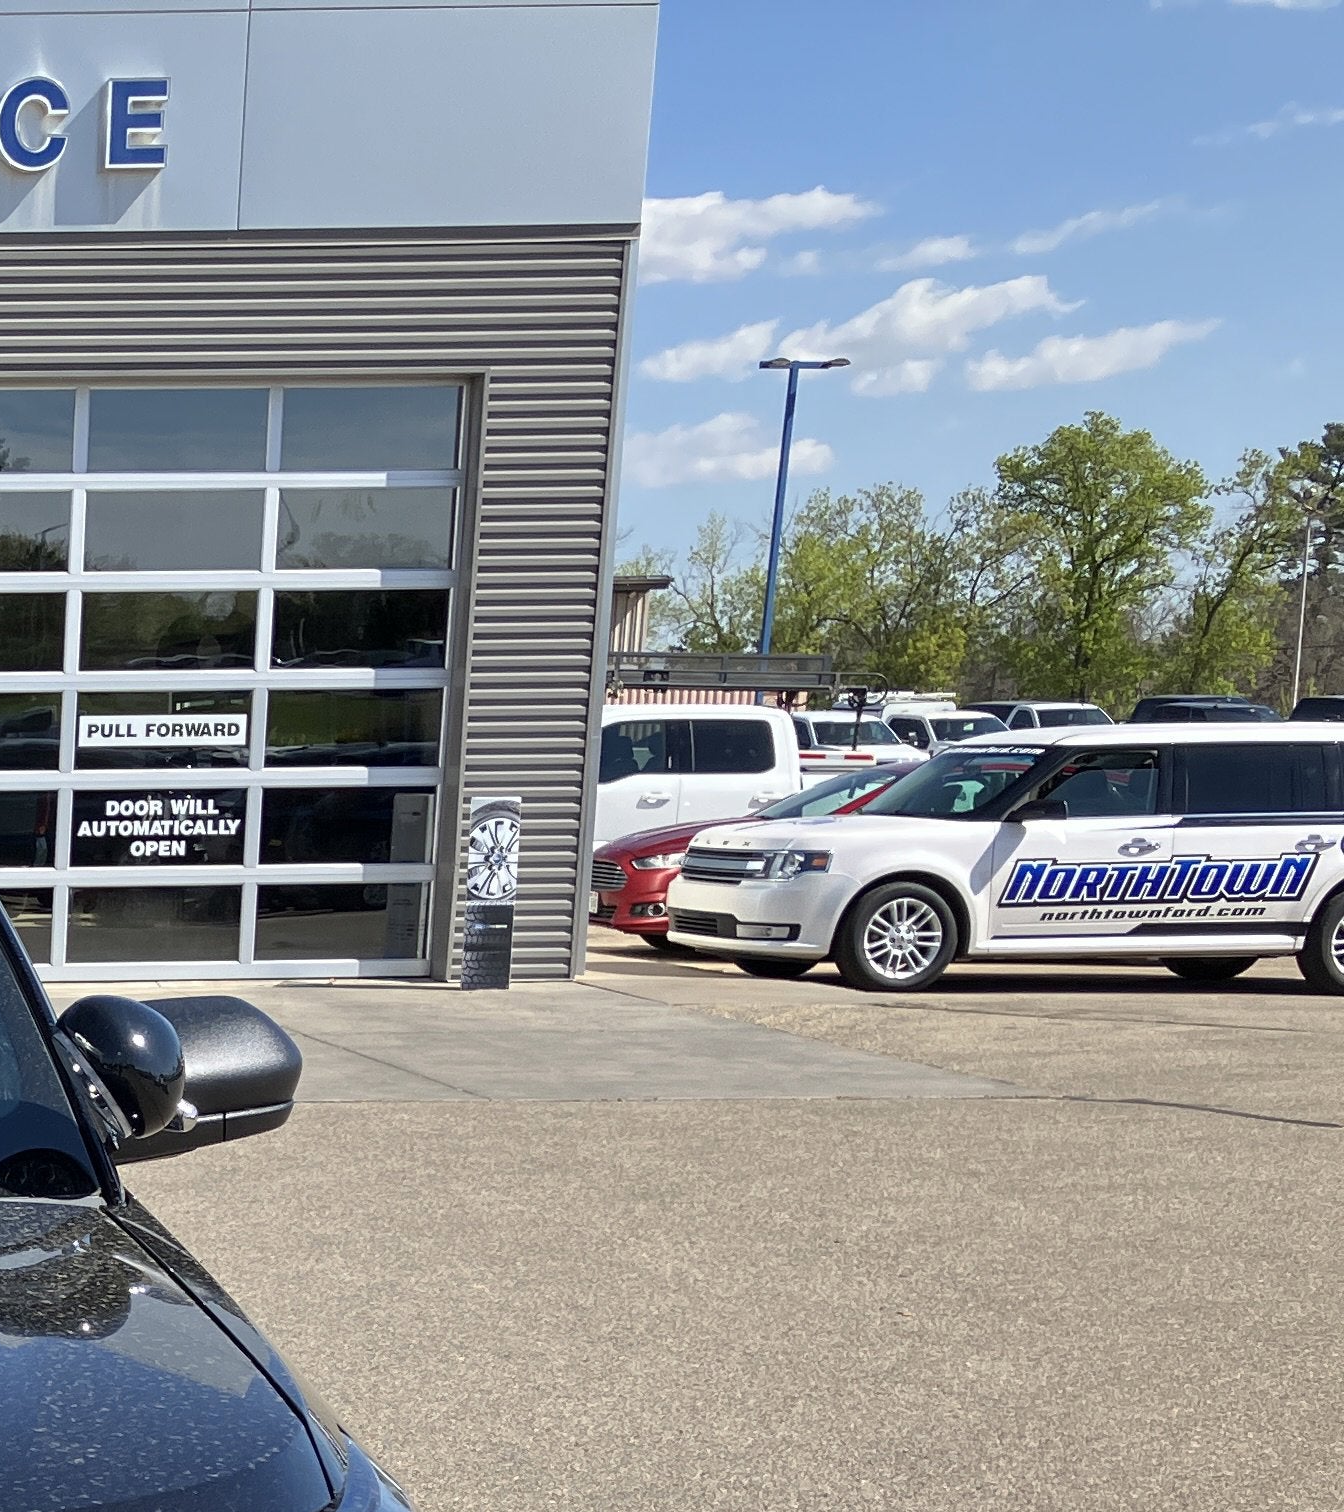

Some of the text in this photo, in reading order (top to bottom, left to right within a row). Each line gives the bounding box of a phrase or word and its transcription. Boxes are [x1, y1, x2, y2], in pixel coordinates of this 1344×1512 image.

[87, 723, 240, 738] PULL FORWARD
[105, 798, 219, 816] DOOR WILL
[77, 819, 242, 837] AUTOMATICALLY
[129, 840, 186, 857] OPEN
[1039, 906, 1266, 922] northtownford.com
